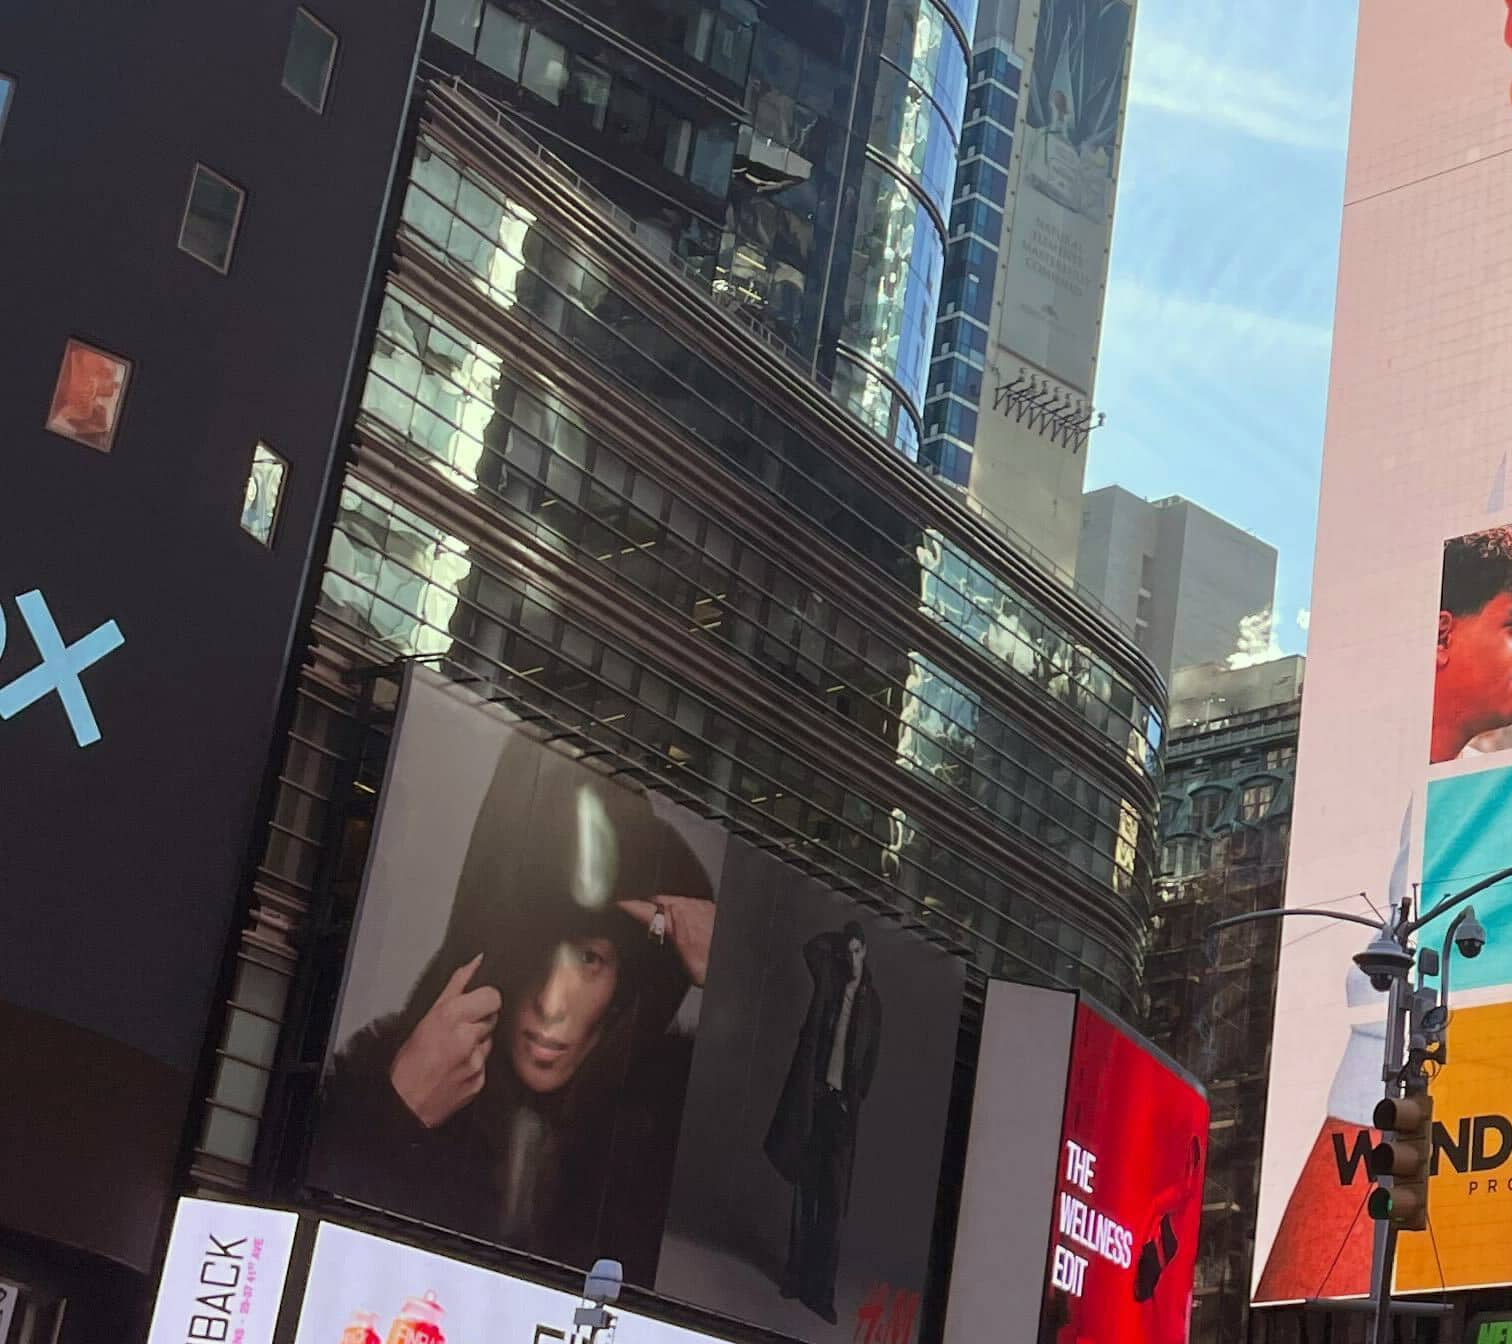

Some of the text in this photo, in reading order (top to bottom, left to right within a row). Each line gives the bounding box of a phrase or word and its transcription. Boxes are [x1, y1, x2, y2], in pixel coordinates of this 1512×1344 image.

[1066, 1139, 1097, 1194] THE
[1058, 1191, 1134, 1270] WELLNESS
[1051, 1244, 1089, 1298] EDIT
